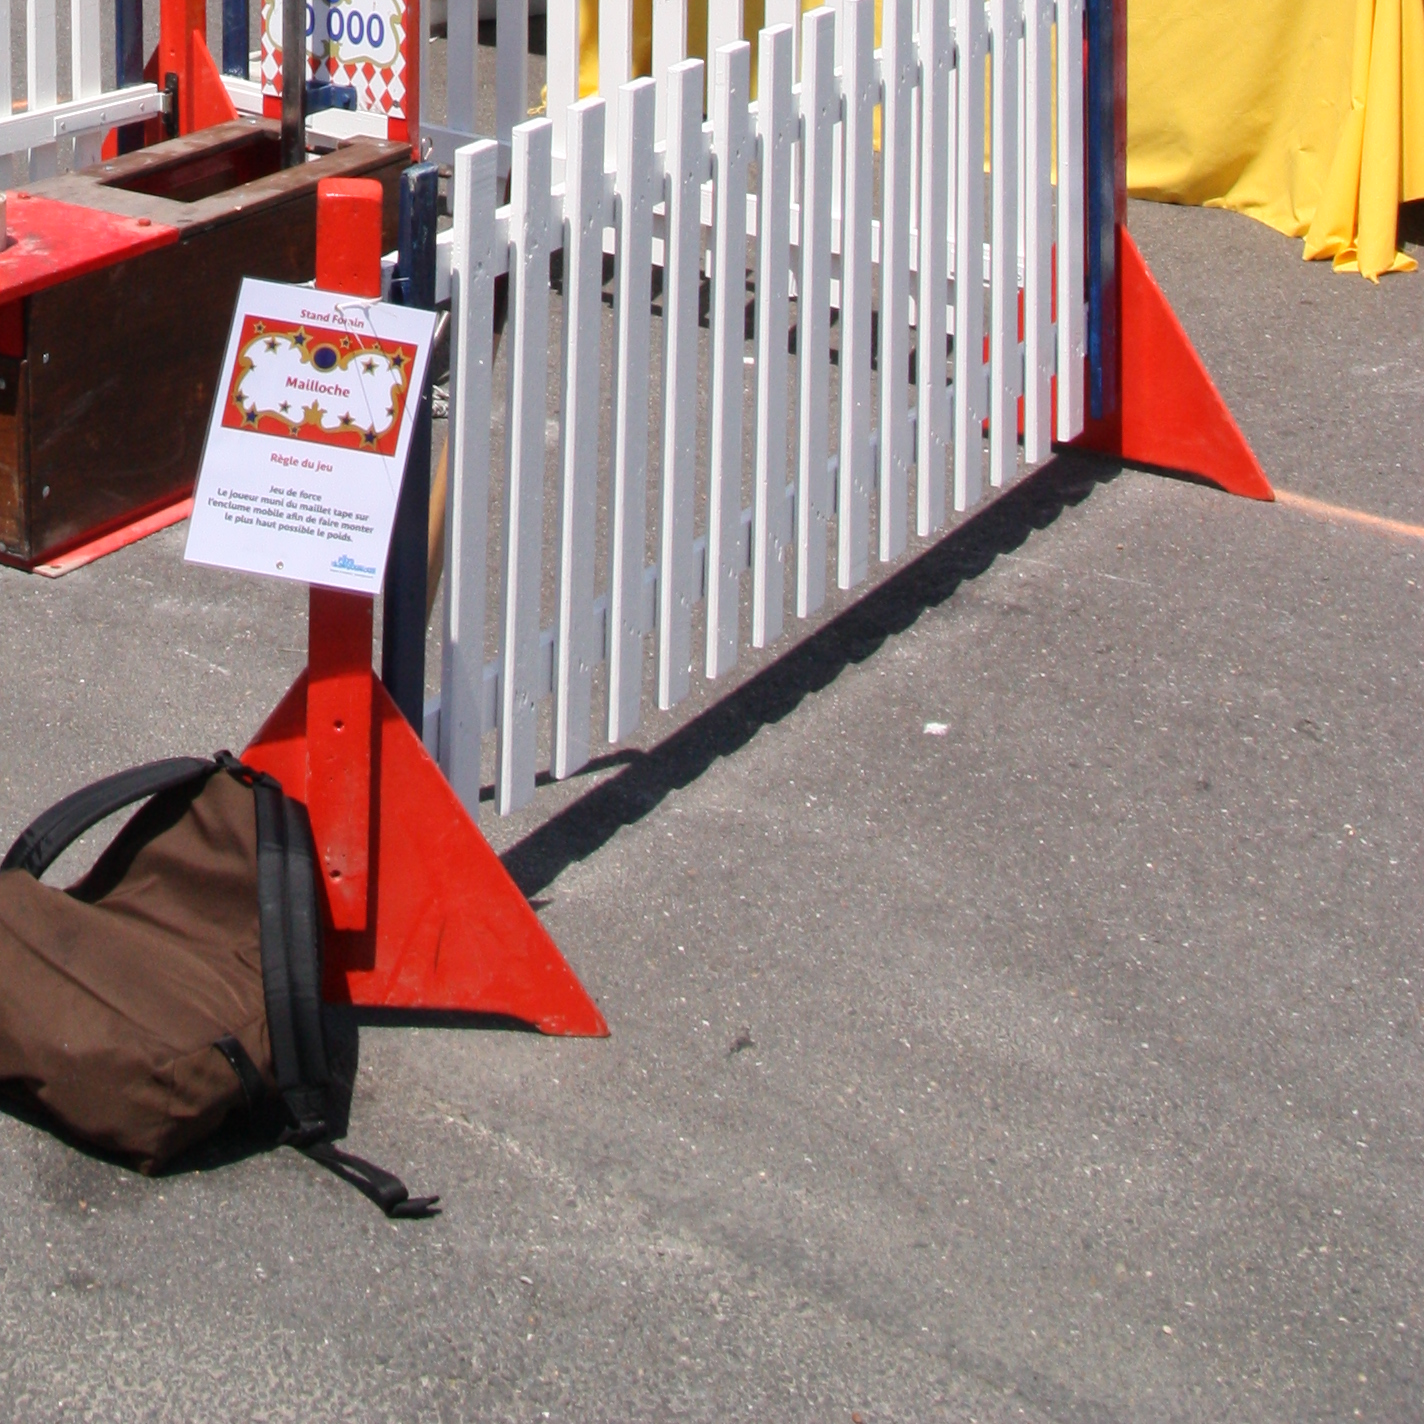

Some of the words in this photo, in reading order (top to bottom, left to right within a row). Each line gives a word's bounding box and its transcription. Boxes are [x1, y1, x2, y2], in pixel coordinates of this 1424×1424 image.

[300, 309, 329, 323] Stand
[285, 376, 351, 398] Mailloche
[270, 453, 299, 467] Règle
[301, 457, 315, 468] du
[315, 461, 334, 473] jeu
[217, 487, 228, 497] Le
[229, 490, 259, 503] joueur
[260, 495, 284, 507] muni
[285, 499, 298, 510] du
[299, 502, 332, 515] maillet
[333, 508, 354, 522] tape
[355, 513, 370, 522] sur
[269, 485, 285, 495] Jeu
[286, 488, 297, 498] de
[299, 490, 322, 502] force
[224, 511, 234, 521] le
[234, 514, 254, 526] plus
[255, 517, 277, 530] haut
[277, 522, 315, 537] possible
[316, 527, 326, 538] le
[252, 505, 284, 519] mobile
[285, 512, 304, 522] afin
[305, 515, 317, 525] de
[318, 516, 339, 529] faire
[340, 522, 375, 534] monter
